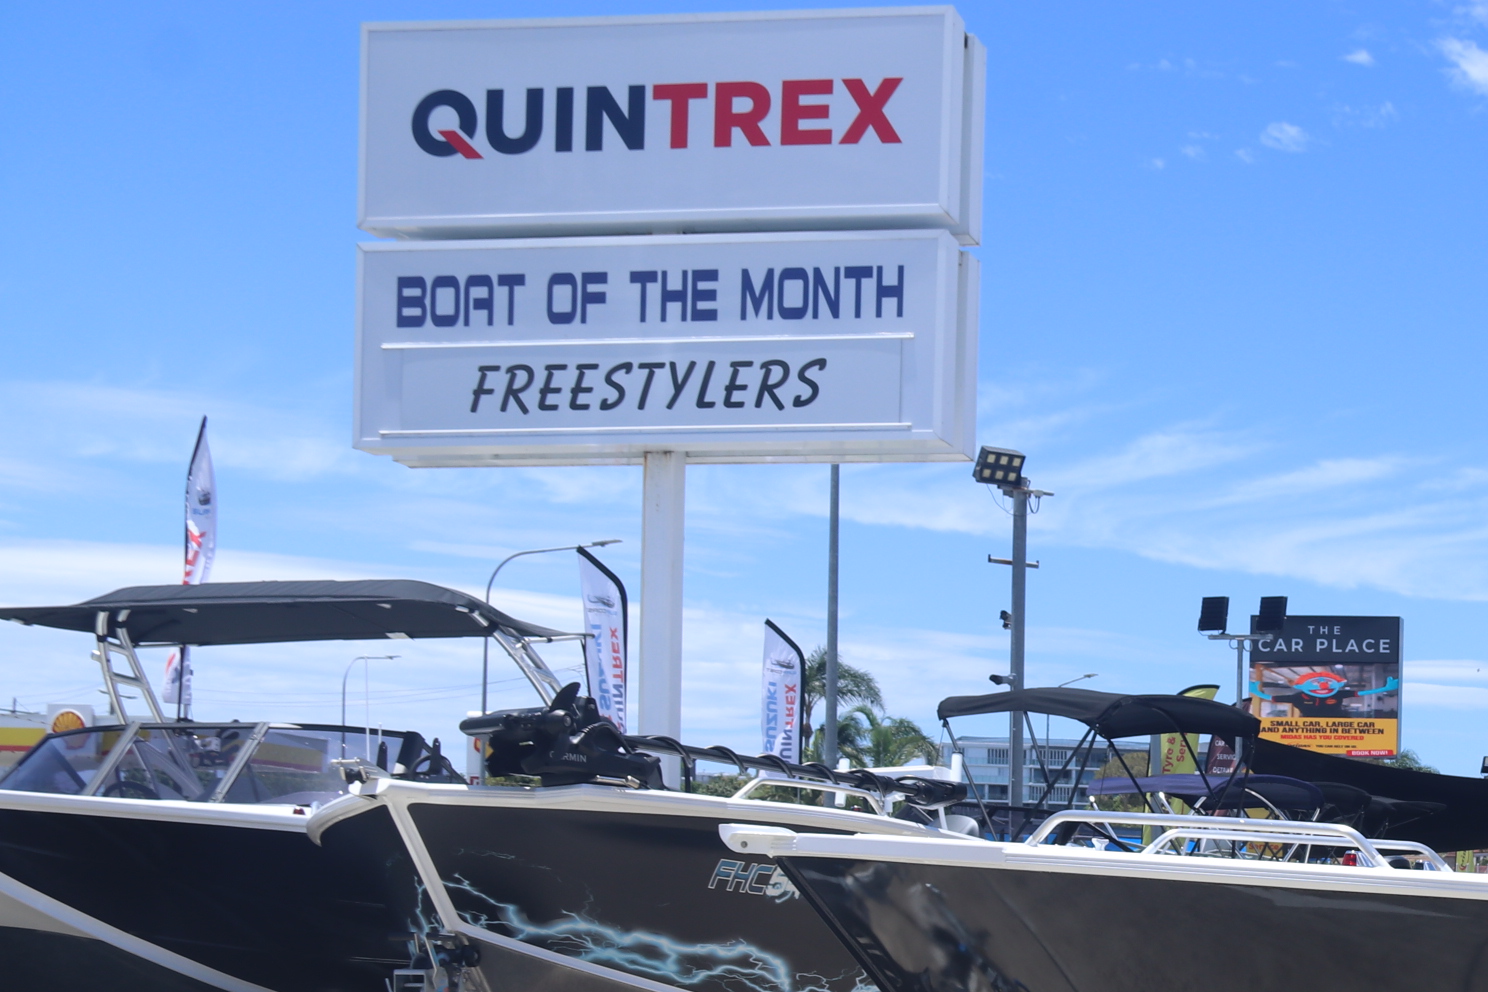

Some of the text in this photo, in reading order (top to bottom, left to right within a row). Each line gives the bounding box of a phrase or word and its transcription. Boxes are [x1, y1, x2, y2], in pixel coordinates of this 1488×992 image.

[411, 77, 904, 159] QUINTREX
[396, 265, 905, 328] BOAT OF THE MONTH
[469, 357, 828, 416] FREESTYLERS
[1307, 625, 1342, 635] THE
[1258, 638, 1391, 653] CAR PLACE
[1162, 745, 1175, 774] Tyre
[1216, 753, 1236, 761] SERVIC
